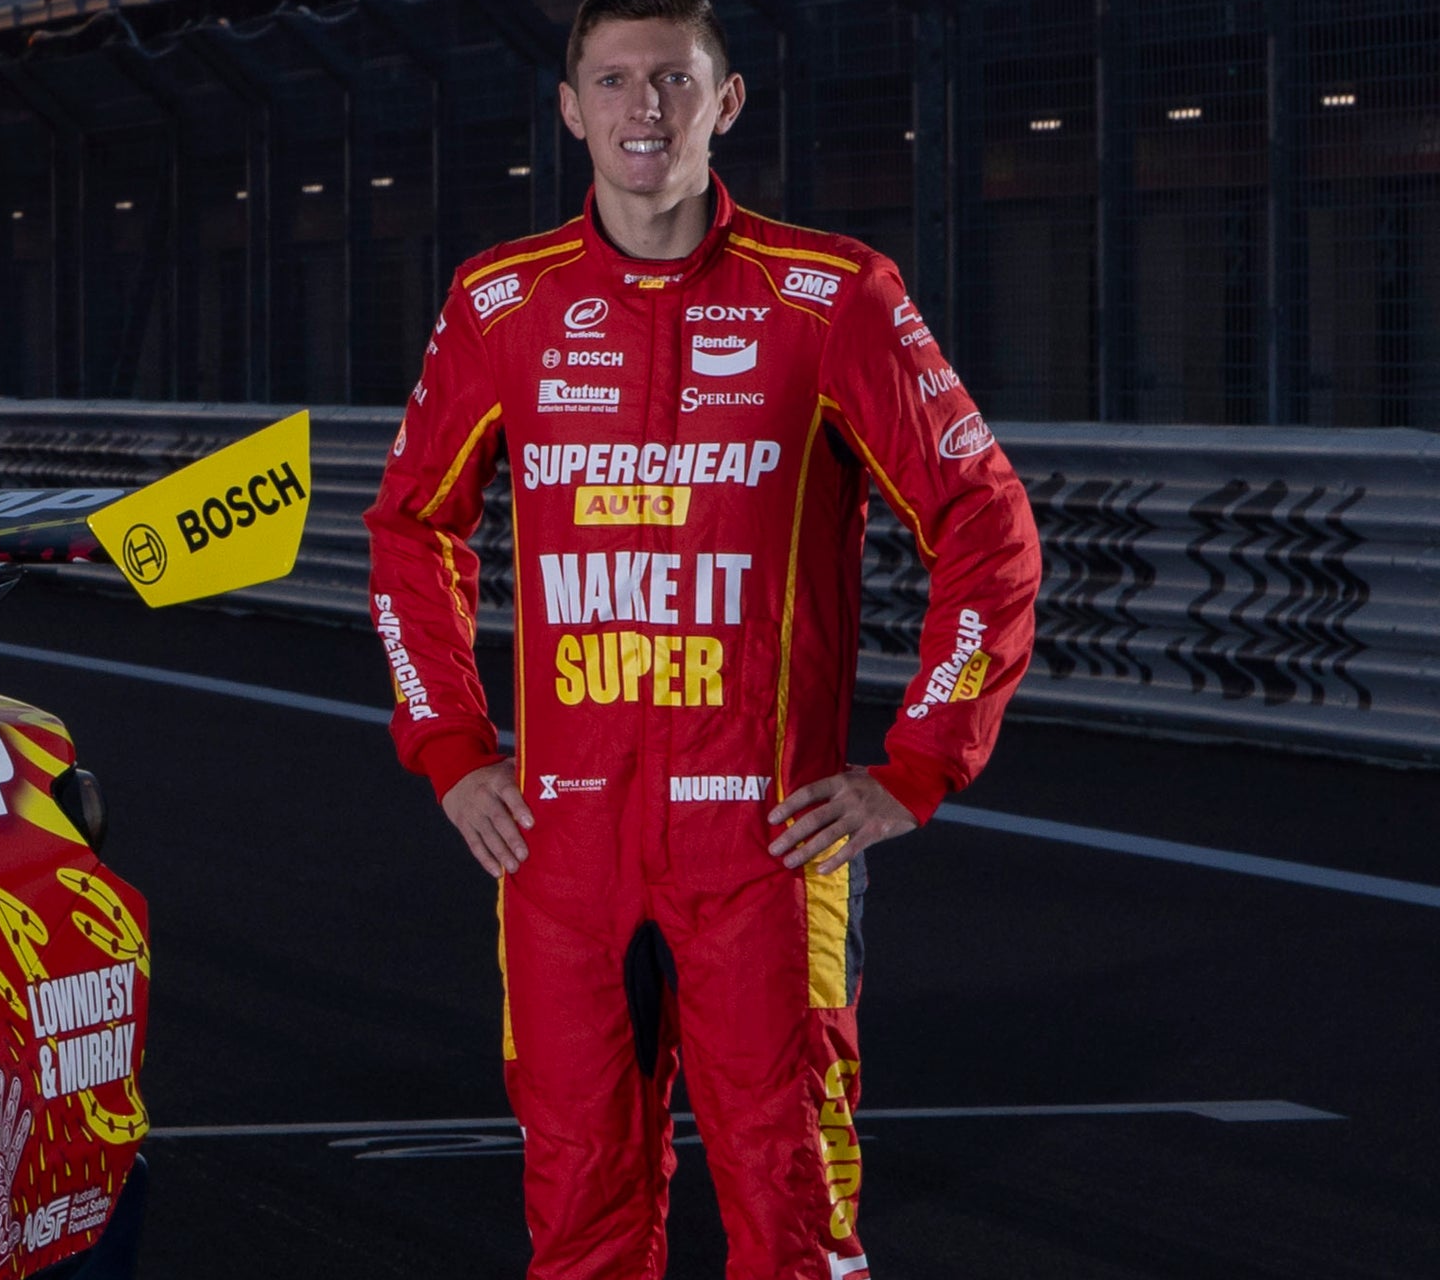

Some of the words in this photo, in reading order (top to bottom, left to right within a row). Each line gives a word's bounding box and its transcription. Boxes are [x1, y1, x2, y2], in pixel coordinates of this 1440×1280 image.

[474, 278, 520, 312] OMP
[784, 272, 839, 299] OMP
[685, 305, 770, 322] SONY
[692, 334, 747, 349] Bendix
[567, 351, 623, 367] BOSCH
[538, 379, 621, 405] Century
[523, 440, 781, 490] SUPERCHEAP
[174, 459, 307, 555] BOSCH
[584, 493, 676, 517] AUTO
[539, 551, 678, 625] MAKE
[695, 553, 752, 625] IT
[555, 630, 723, 707] SUPER
[959, 658, 983, 697] UTO
[669, 775, 772, 802] MURRAY
[26, 961, 136, 1039] LOWNDESY
[39, 1044, 58, 1100] &
[57, 1022, 137, 1096] MURRAY
